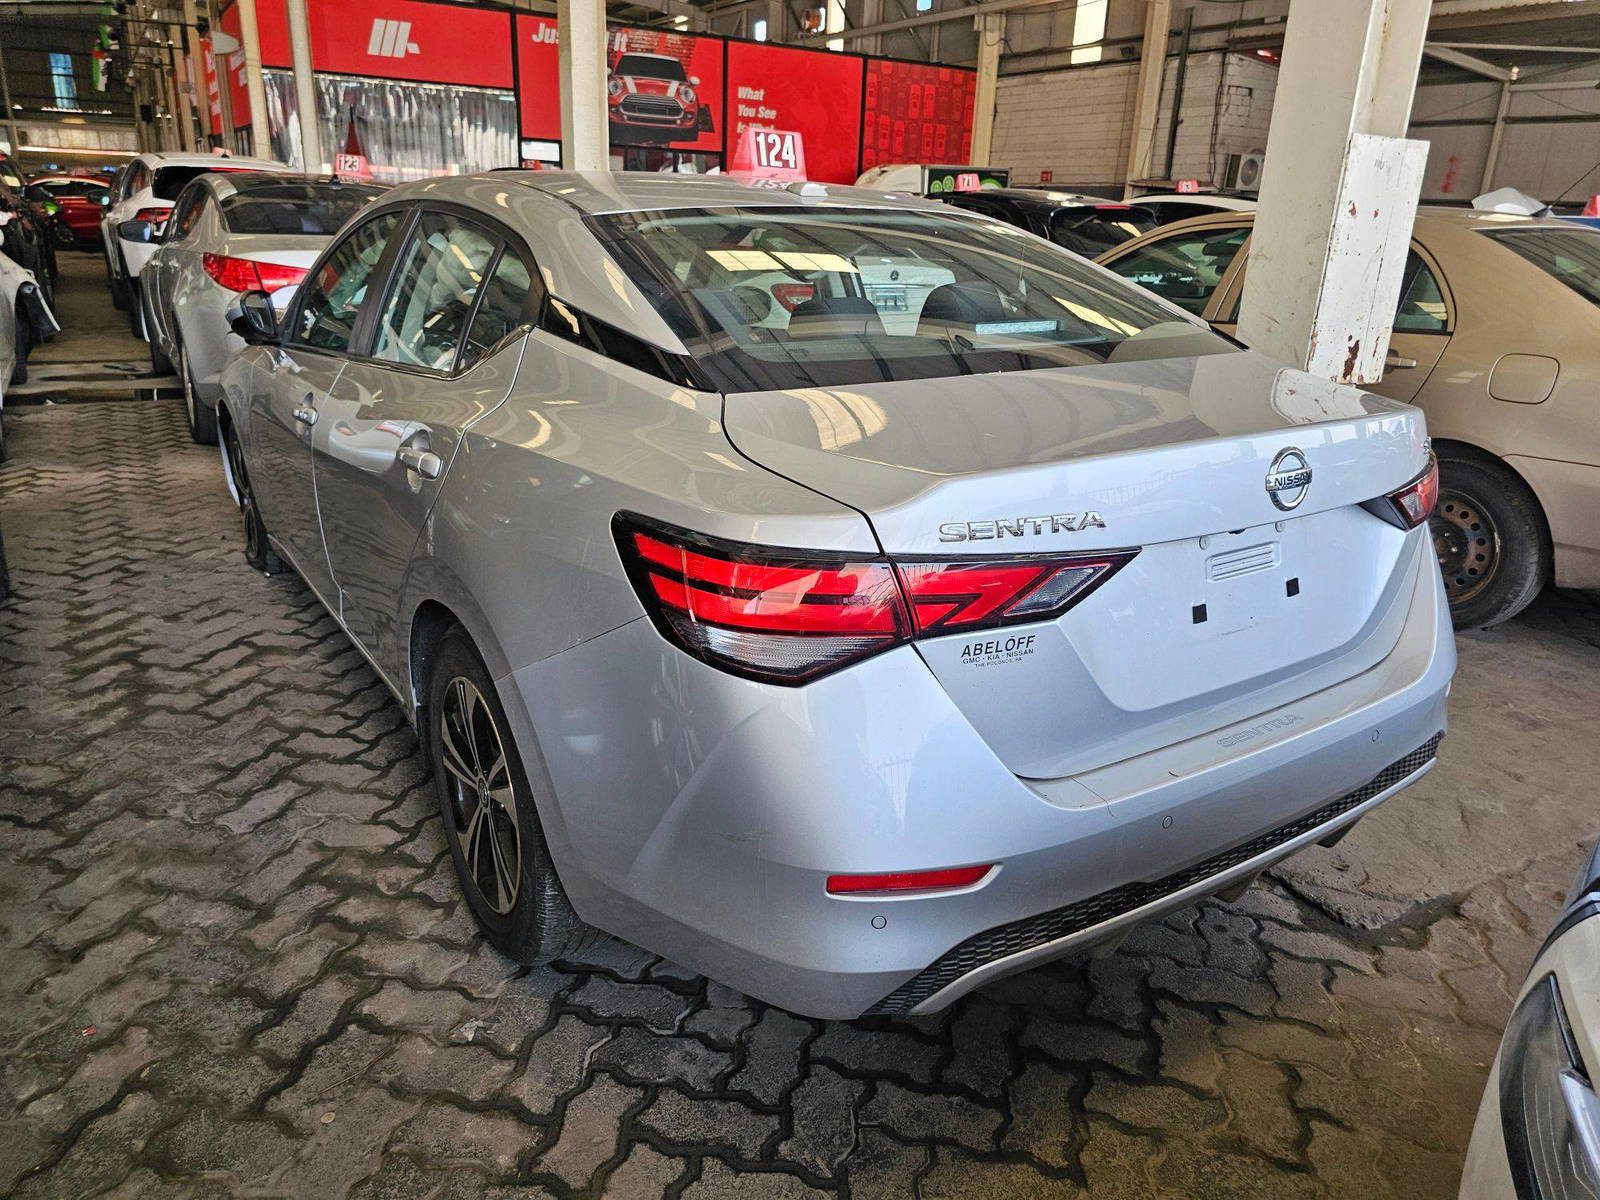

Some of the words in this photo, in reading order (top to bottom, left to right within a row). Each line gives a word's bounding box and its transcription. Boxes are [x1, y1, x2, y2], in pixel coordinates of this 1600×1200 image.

[532, 22, 559, 44] Ju
[614, 32, 628, 52] It
[737, 86, 764, 101] What
[737, 104, 756, 117] You
[758, 106, 777, 119] See
[756, 132, 796, 168] 124
[340, 155, 360, 171] 123
[963, 175, 973, 187] 71
[939, 511, 1107, 542] SENTRA
[962, 656, 981, 664] GMC
[987, 653, 1000, 661] KIA
[1006, 648, 1034, 658] NISSAN
[1216, 714, 1304, 748] SENTRA
